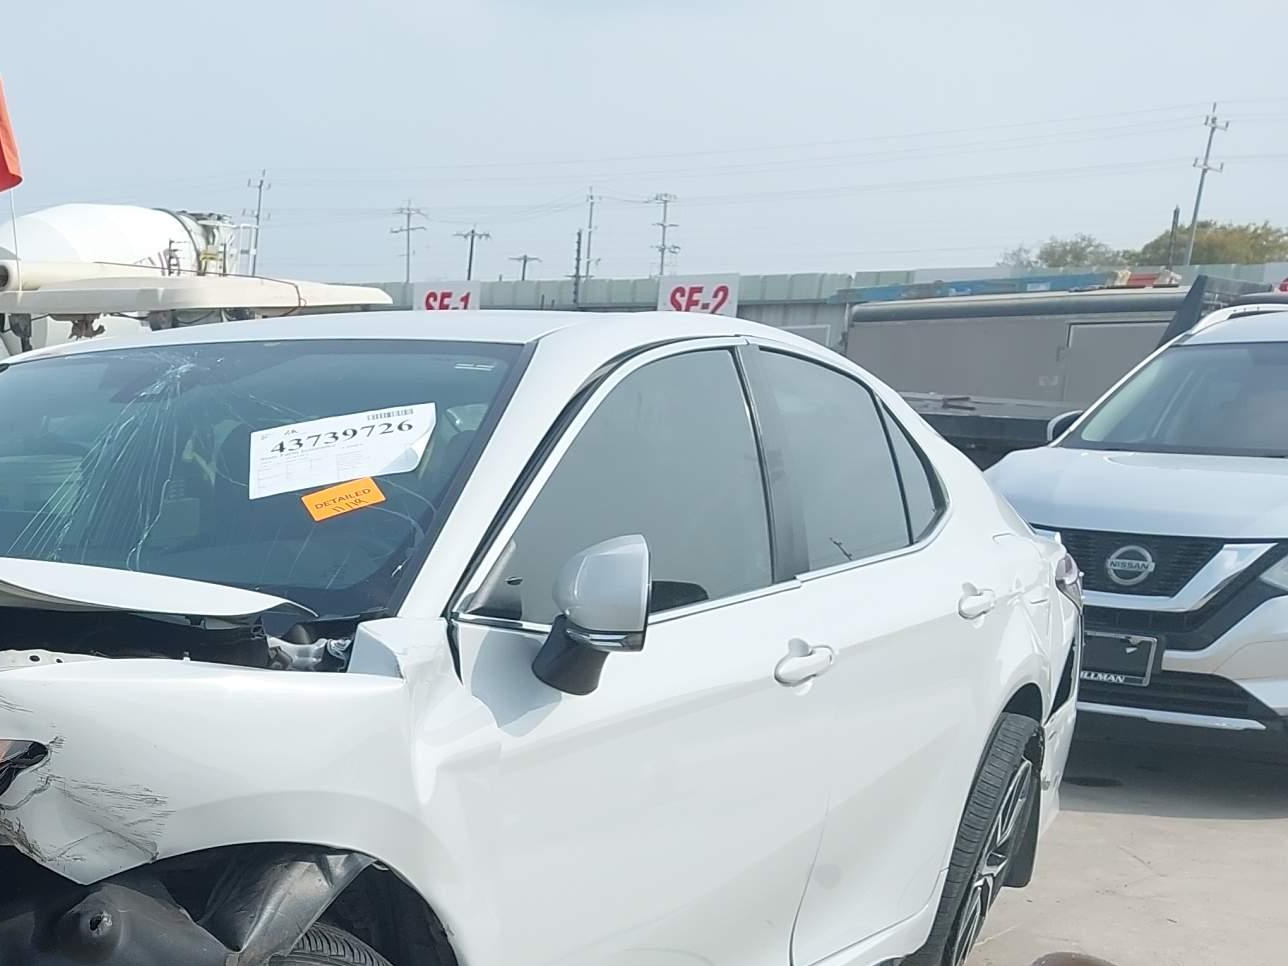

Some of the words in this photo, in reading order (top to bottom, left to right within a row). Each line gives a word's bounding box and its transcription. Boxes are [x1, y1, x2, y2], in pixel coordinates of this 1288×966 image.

[270, 419, 415, 454] 43739726
[314, 487, 372, 510] DETAILED
[1109, 560, 1150, 570] NISSAN
